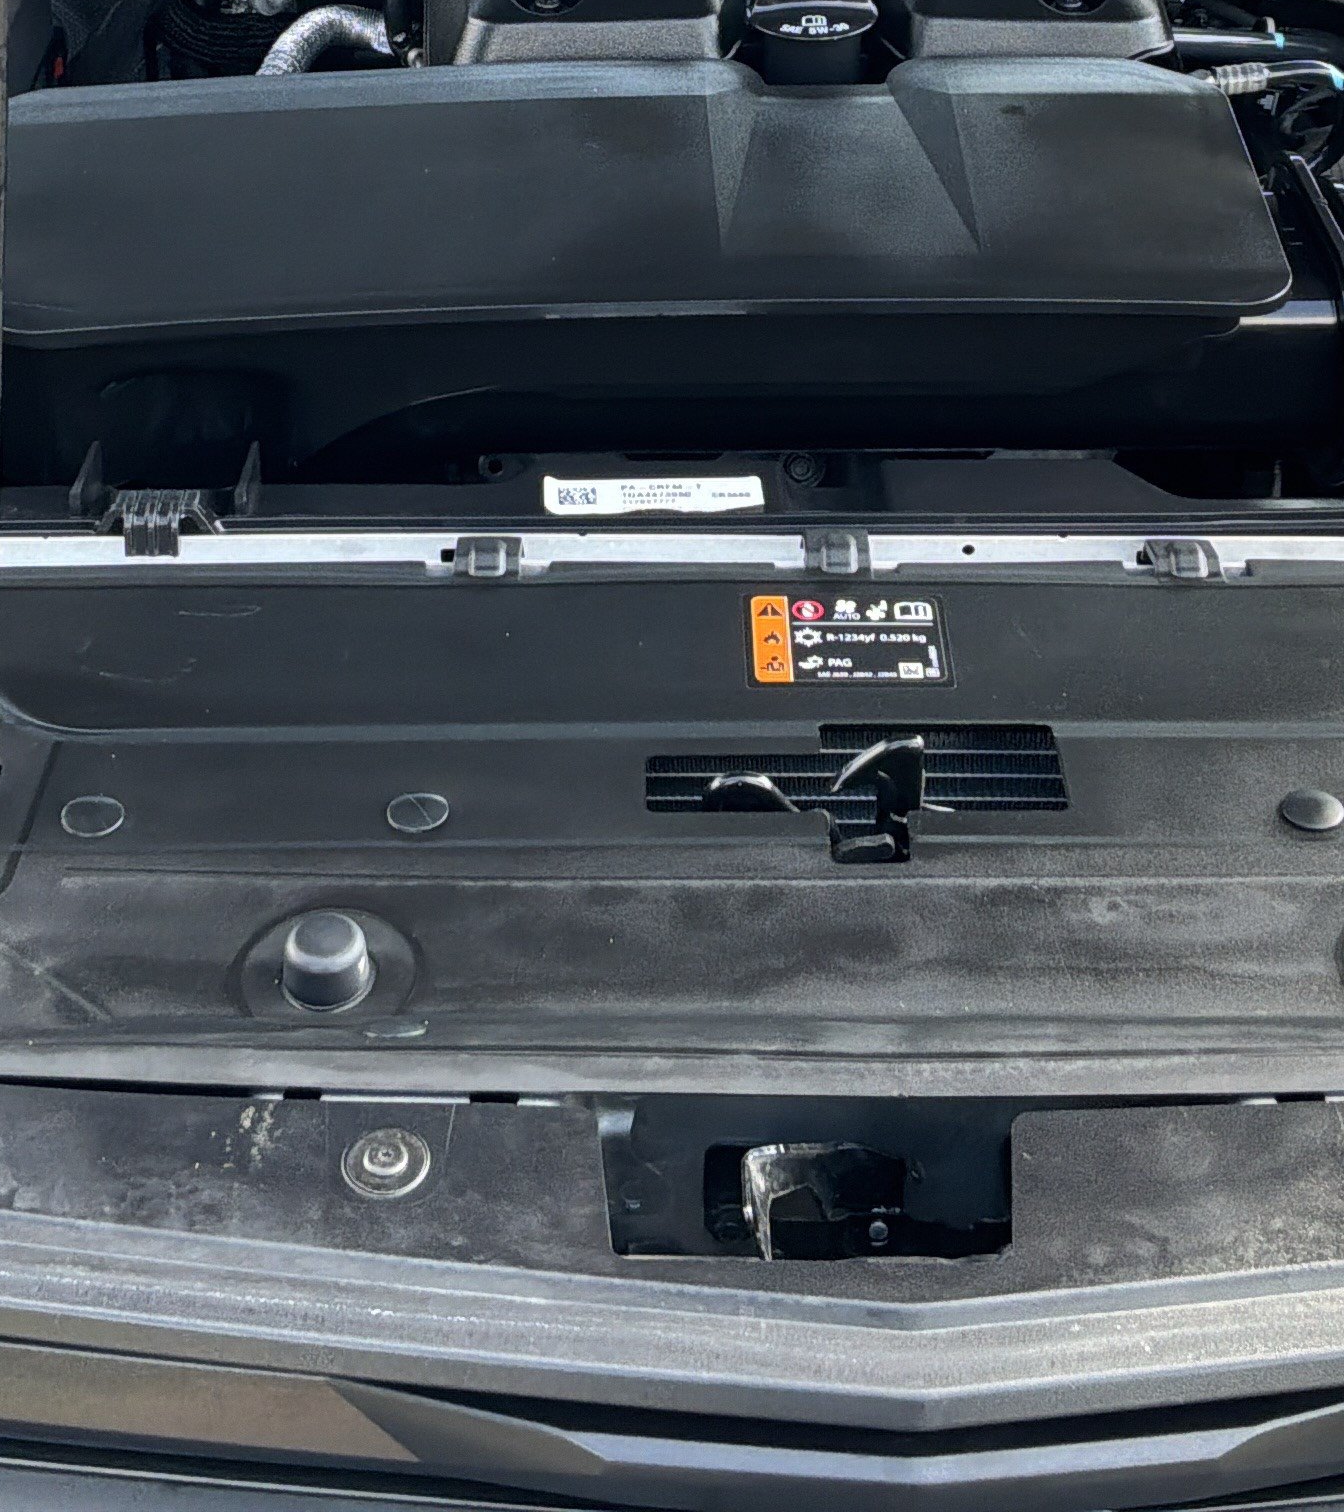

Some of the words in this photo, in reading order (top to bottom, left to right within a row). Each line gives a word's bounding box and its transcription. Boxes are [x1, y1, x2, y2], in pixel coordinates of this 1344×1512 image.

[833, 612, 861, 621] AUTO
[825, 633, 876, 644] R-1234yf
[879, 633, 911, 642] 0.520
[912, 633, 927, 644] kg
[827, 658, 853, 667] PAG
